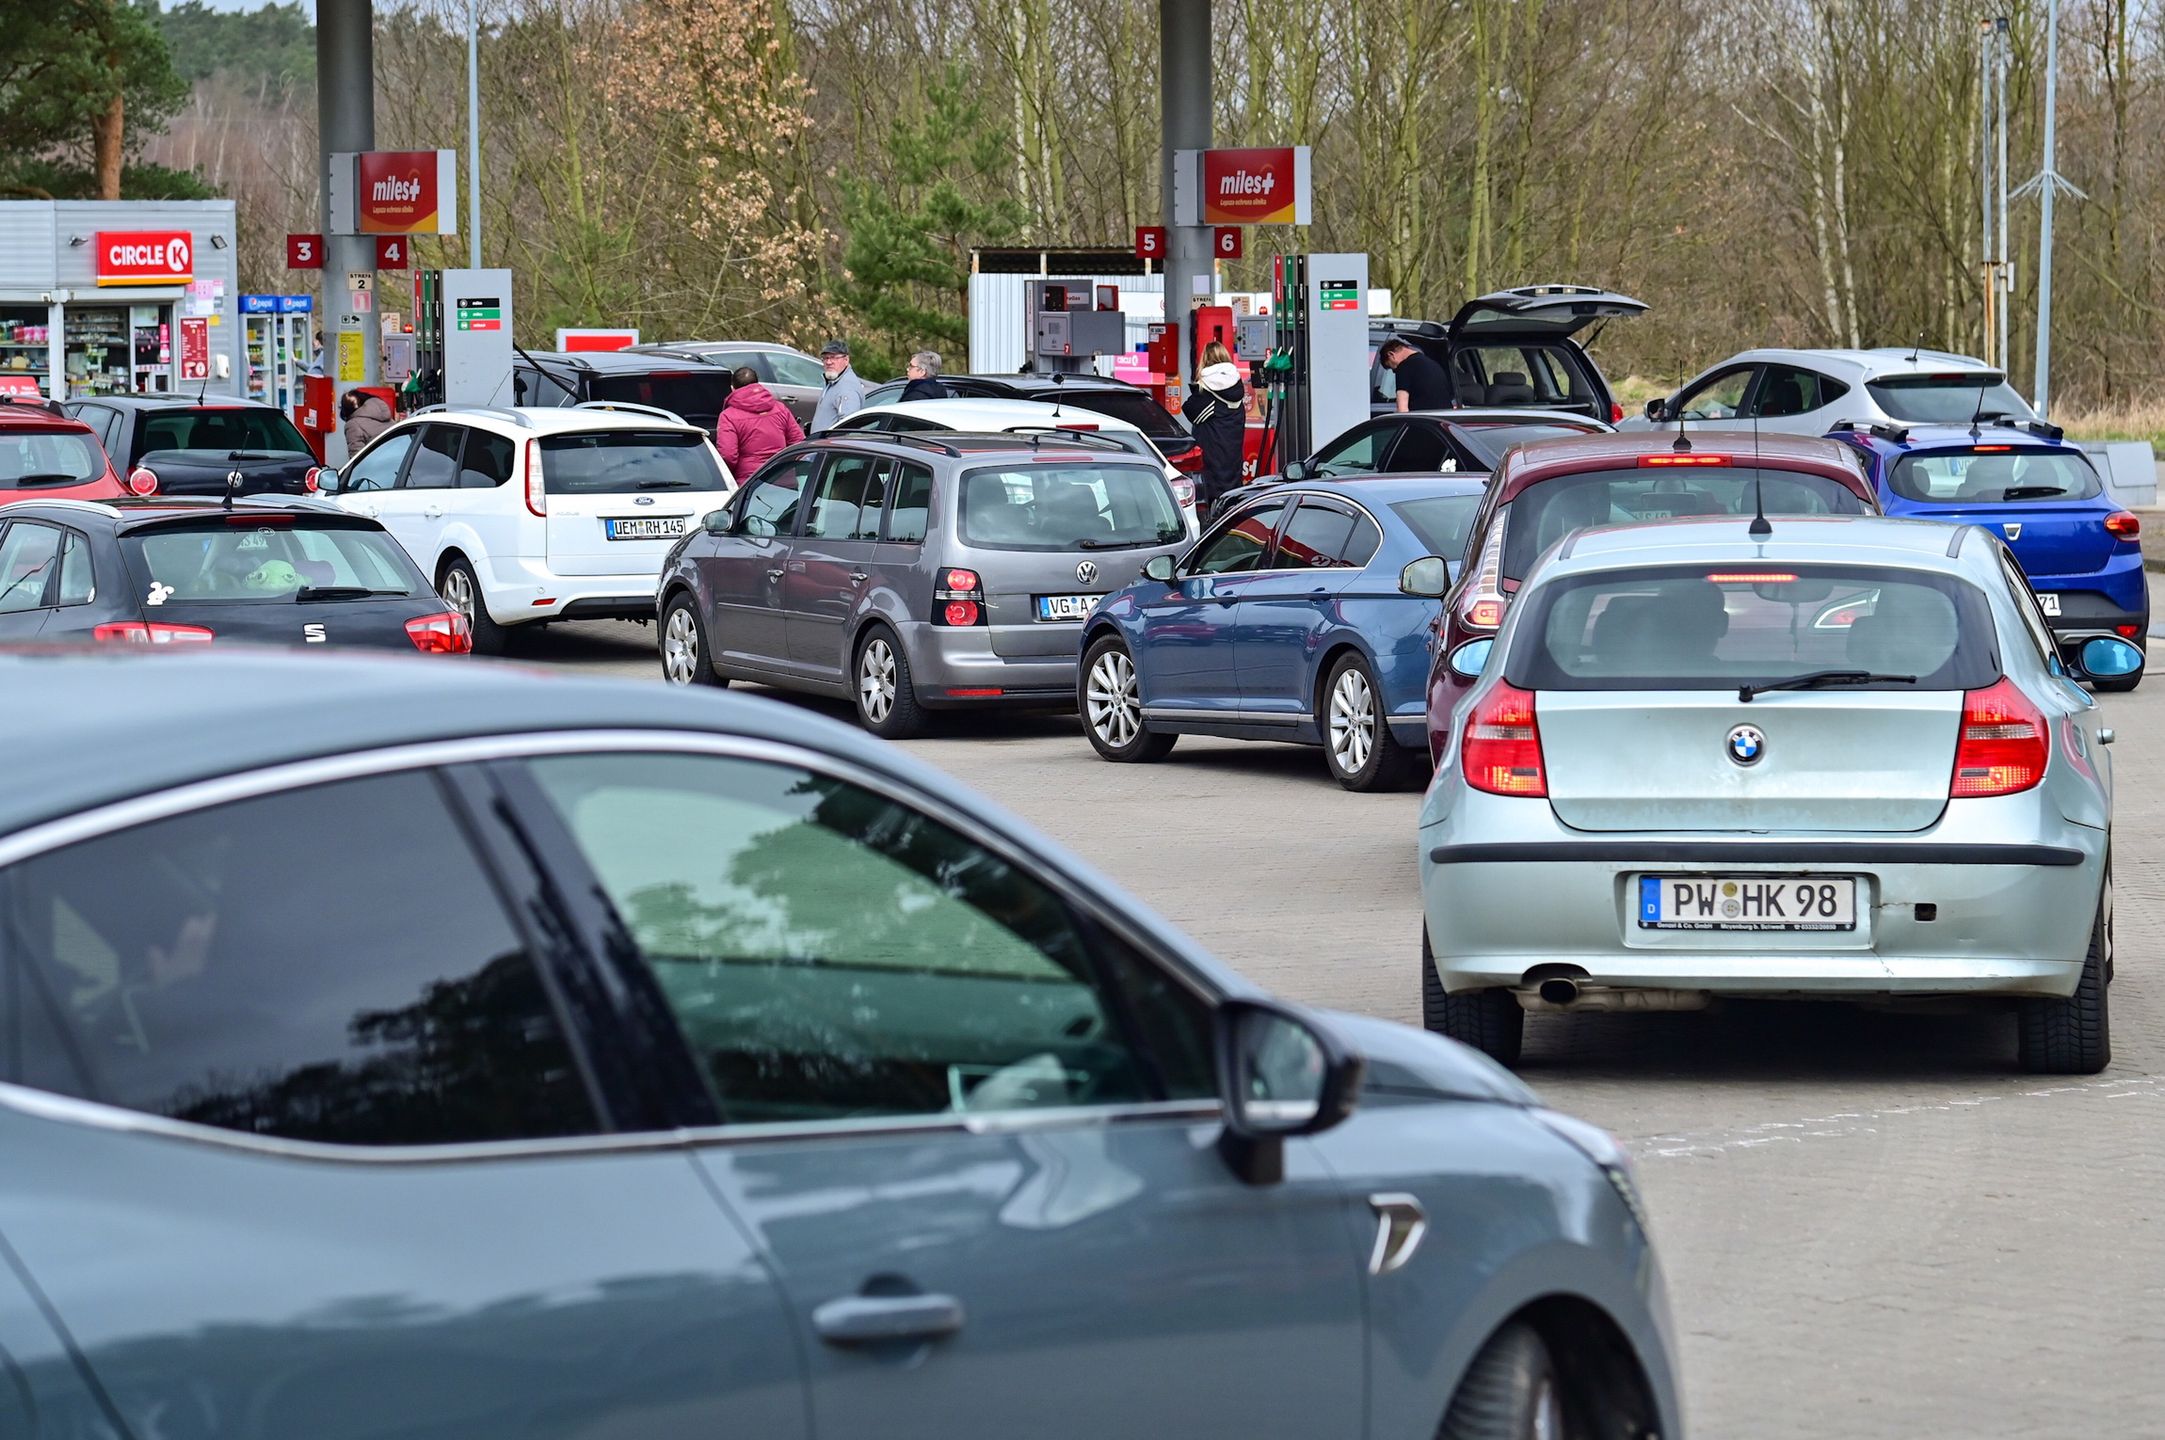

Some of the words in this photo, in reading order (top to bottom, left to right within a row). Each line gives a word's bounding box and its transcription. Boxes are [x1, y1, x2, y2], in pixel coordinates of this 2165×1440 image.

[372, 175, 420, 202] miles+
[1219, 170, 1275, 195] miles+
[1143, 233, 1155, 251] 5
[1221, 233, 1234, 252] 6
[109, 245, 164, 266] CIRCLE
[297, 242, 312, 261] 3
[384, 243, 400, 261] 4
[358, 280, 366, 289] 2
[614, 521, 638, 535] UEM
[645, 521, 660, 534] RH
[663, 520, 684, 534] 145
[1049, 598, 1070, 614] VG
[1080, 598, 1089, 613] A
[2039, 596, 2057, 610] 71
[1647, 904, 1656, 914] D
[1673, 883, 1717, 916] PW
[1742, 884, 1786, 917] HK
[1796, 884, 1837, 917] 98
